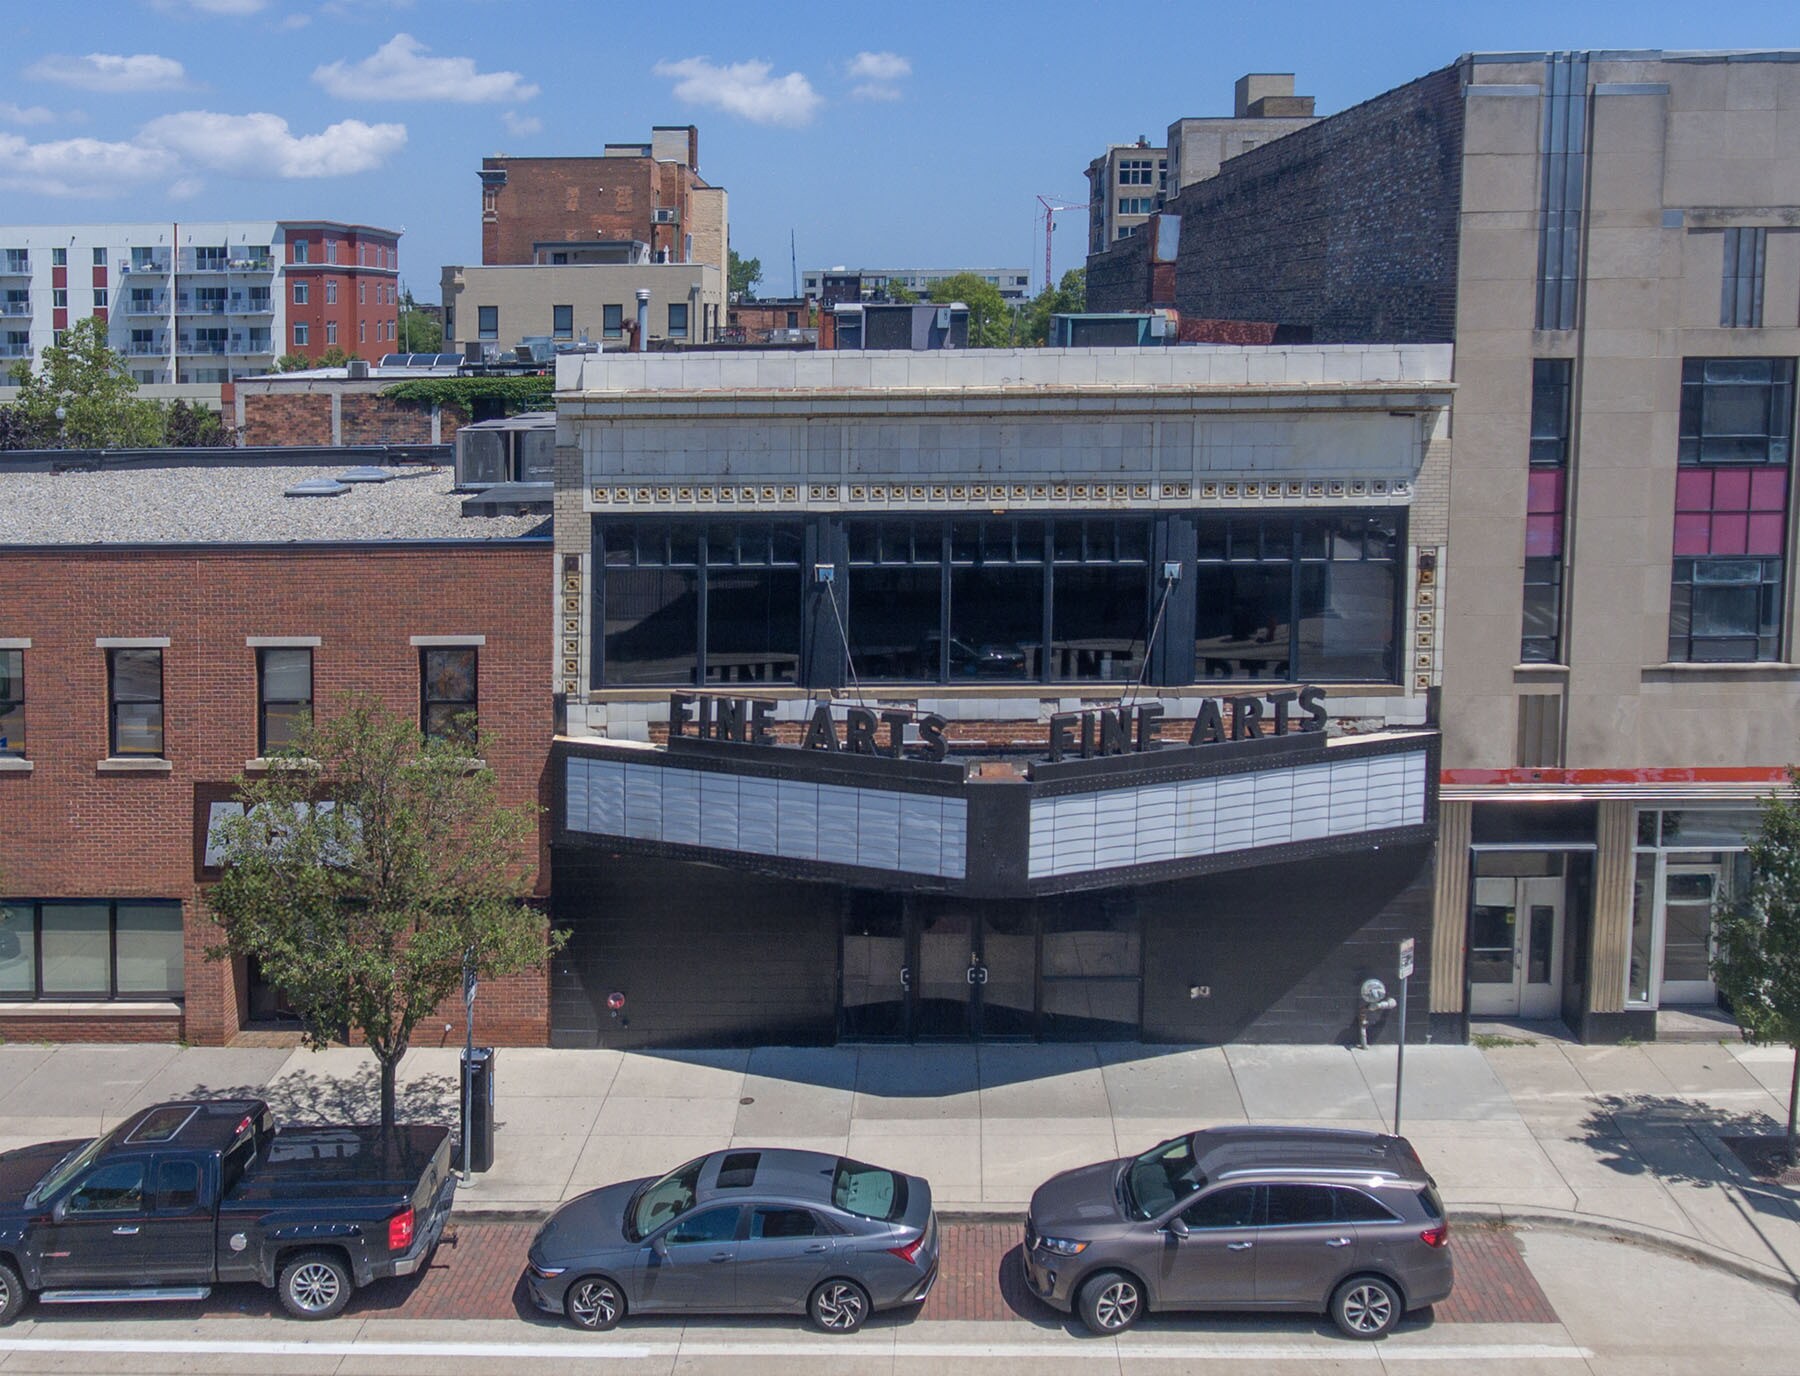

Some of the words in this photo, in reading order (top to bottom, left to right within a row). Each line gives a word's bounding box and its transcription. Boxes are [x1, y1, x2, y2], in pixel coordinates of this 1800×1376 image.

[670, 693, 777, 745] FINE
[802, 705, 948, 761] ARTS
[1051, 703, 1164, 762] FINE
[1189, 686, 1328, 746] ARTS
